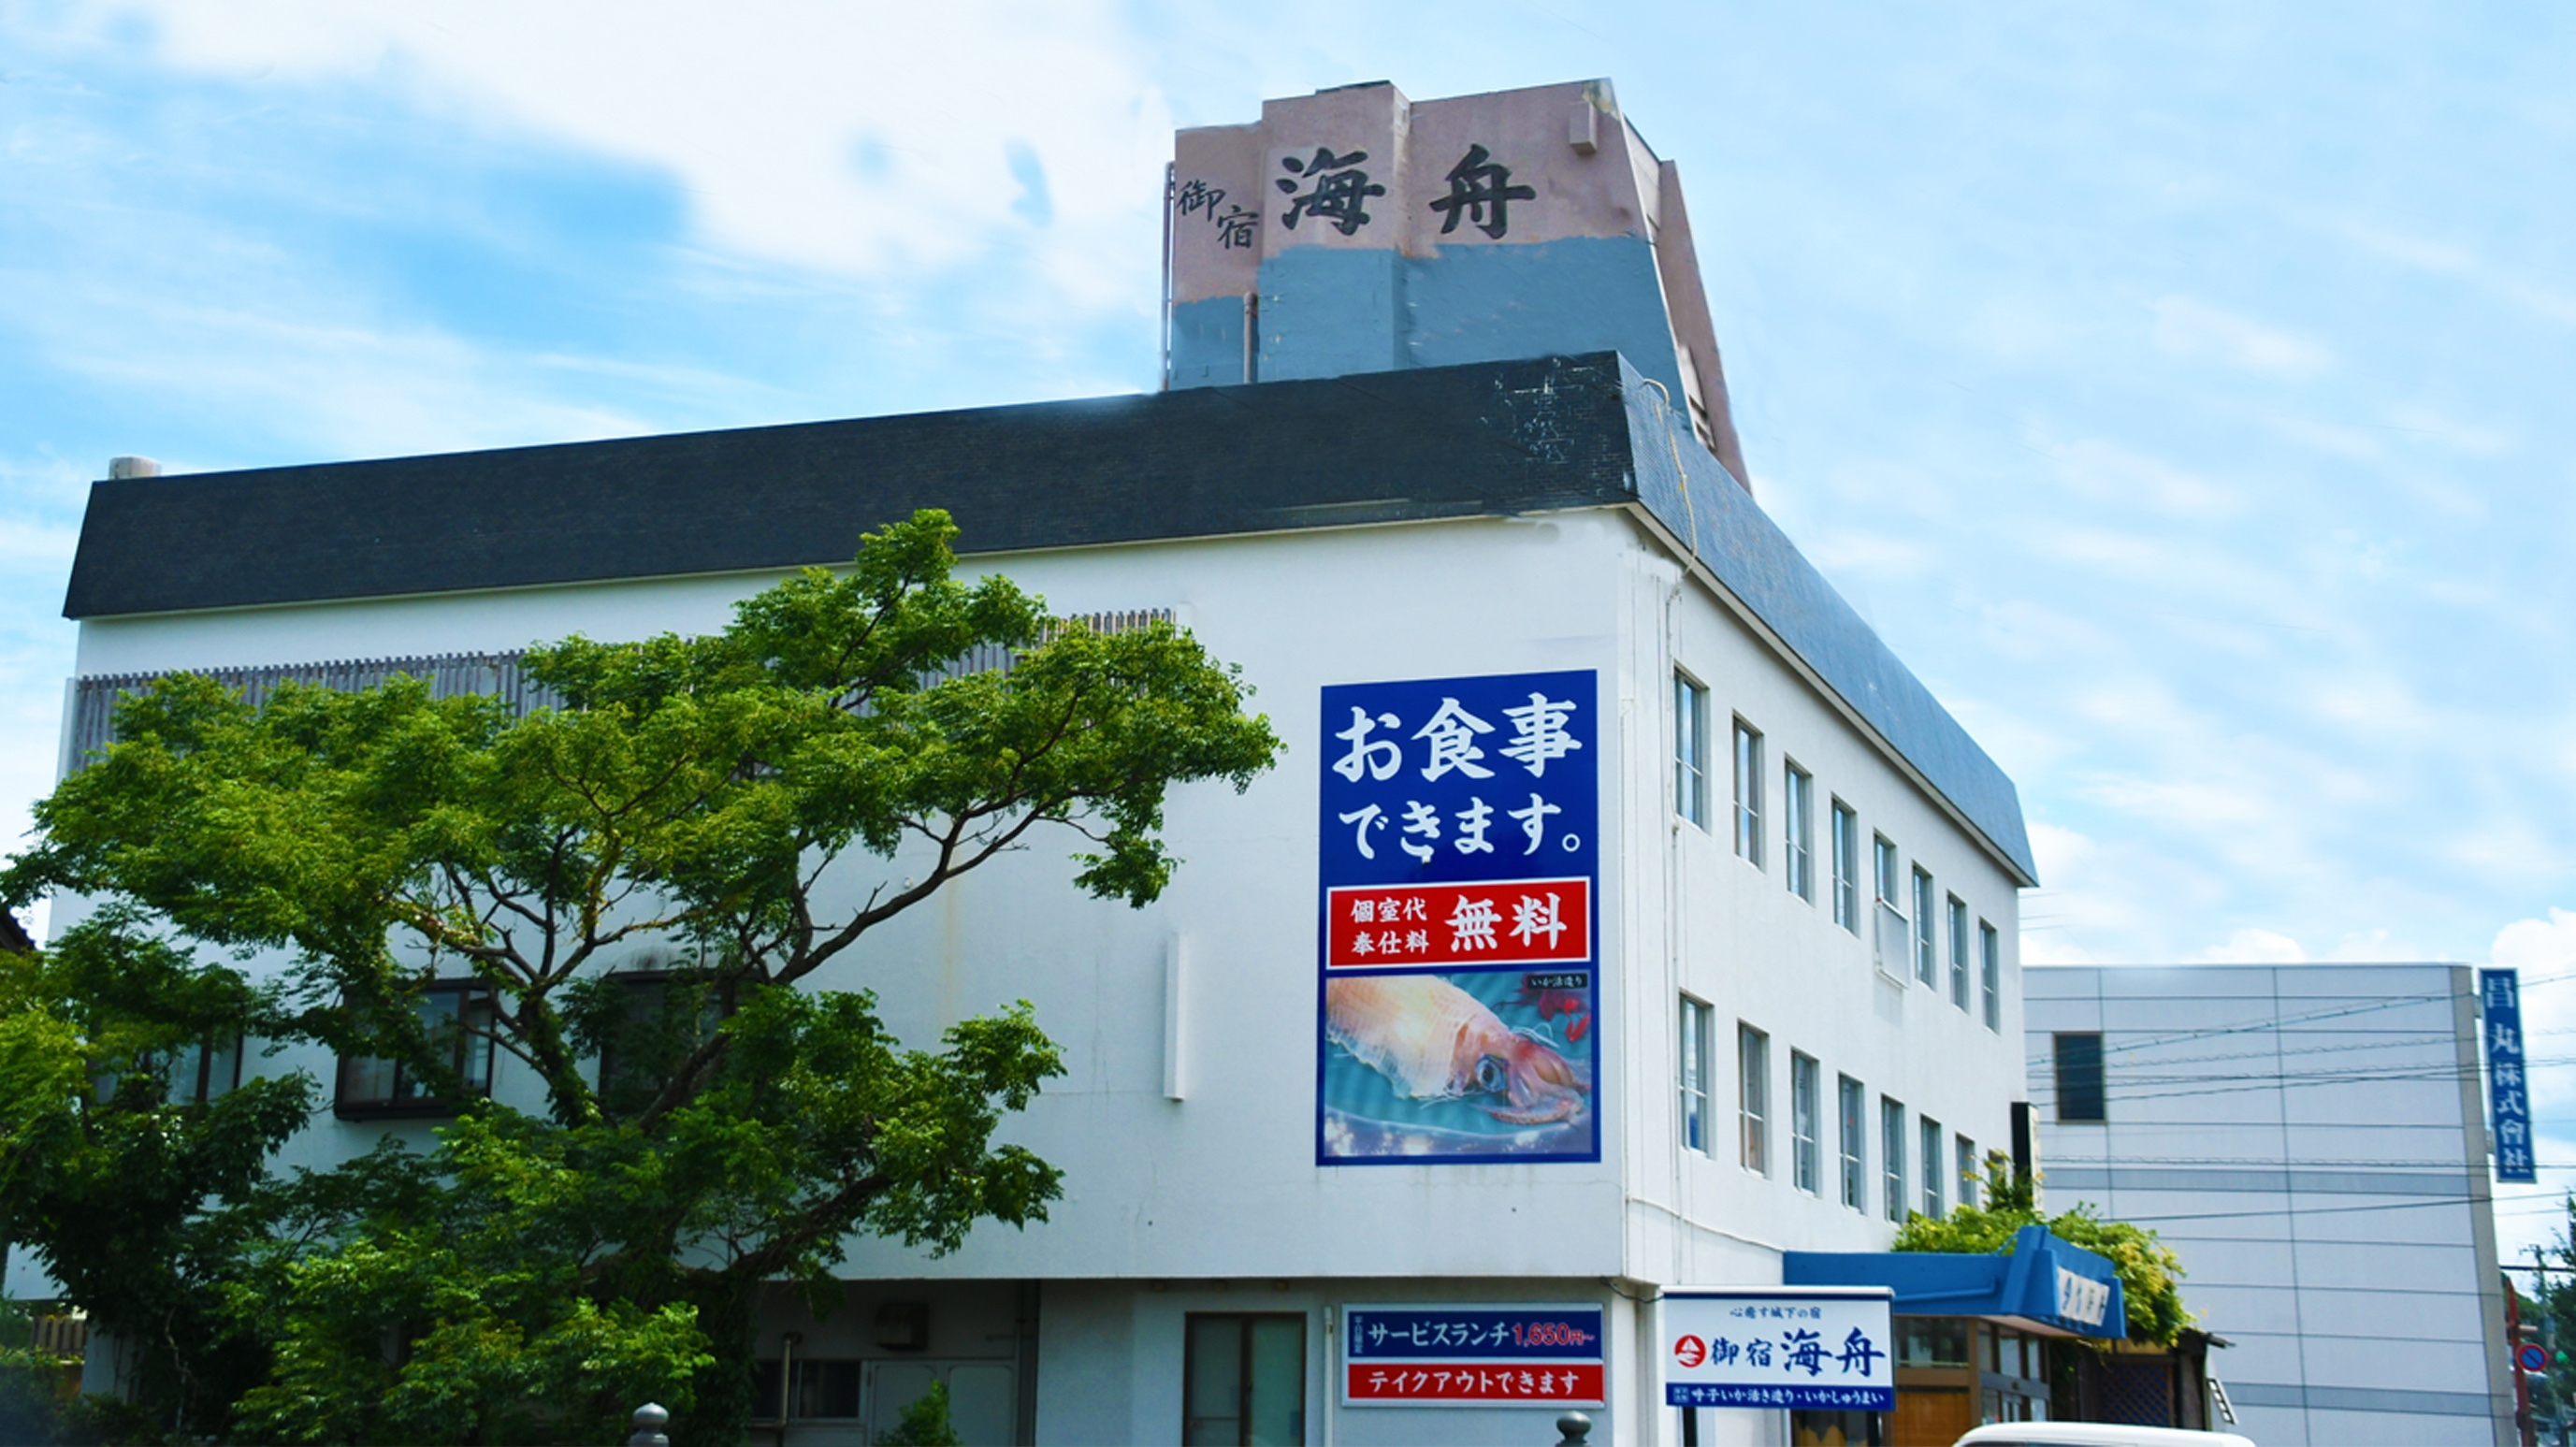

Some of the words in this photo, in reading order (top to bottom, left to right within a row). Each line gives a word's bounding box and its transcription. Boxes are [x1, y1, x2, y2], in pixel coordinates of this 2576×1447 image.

[1275, 143, 1536, 239] 海舟
[1332, 691, 1583, 783] お食事
[1339, 792, 1581, 860] できます。
[1351, 896, 1427, 923] 個室代
[1444, 891, 1568, 952] 無料
[1351, 929, 1429, 956] 奉仕料
[1368, 1320, 1510, 1347] サービスランチ
[1368, 1370, 1580, 1396] テイクアウトできます
